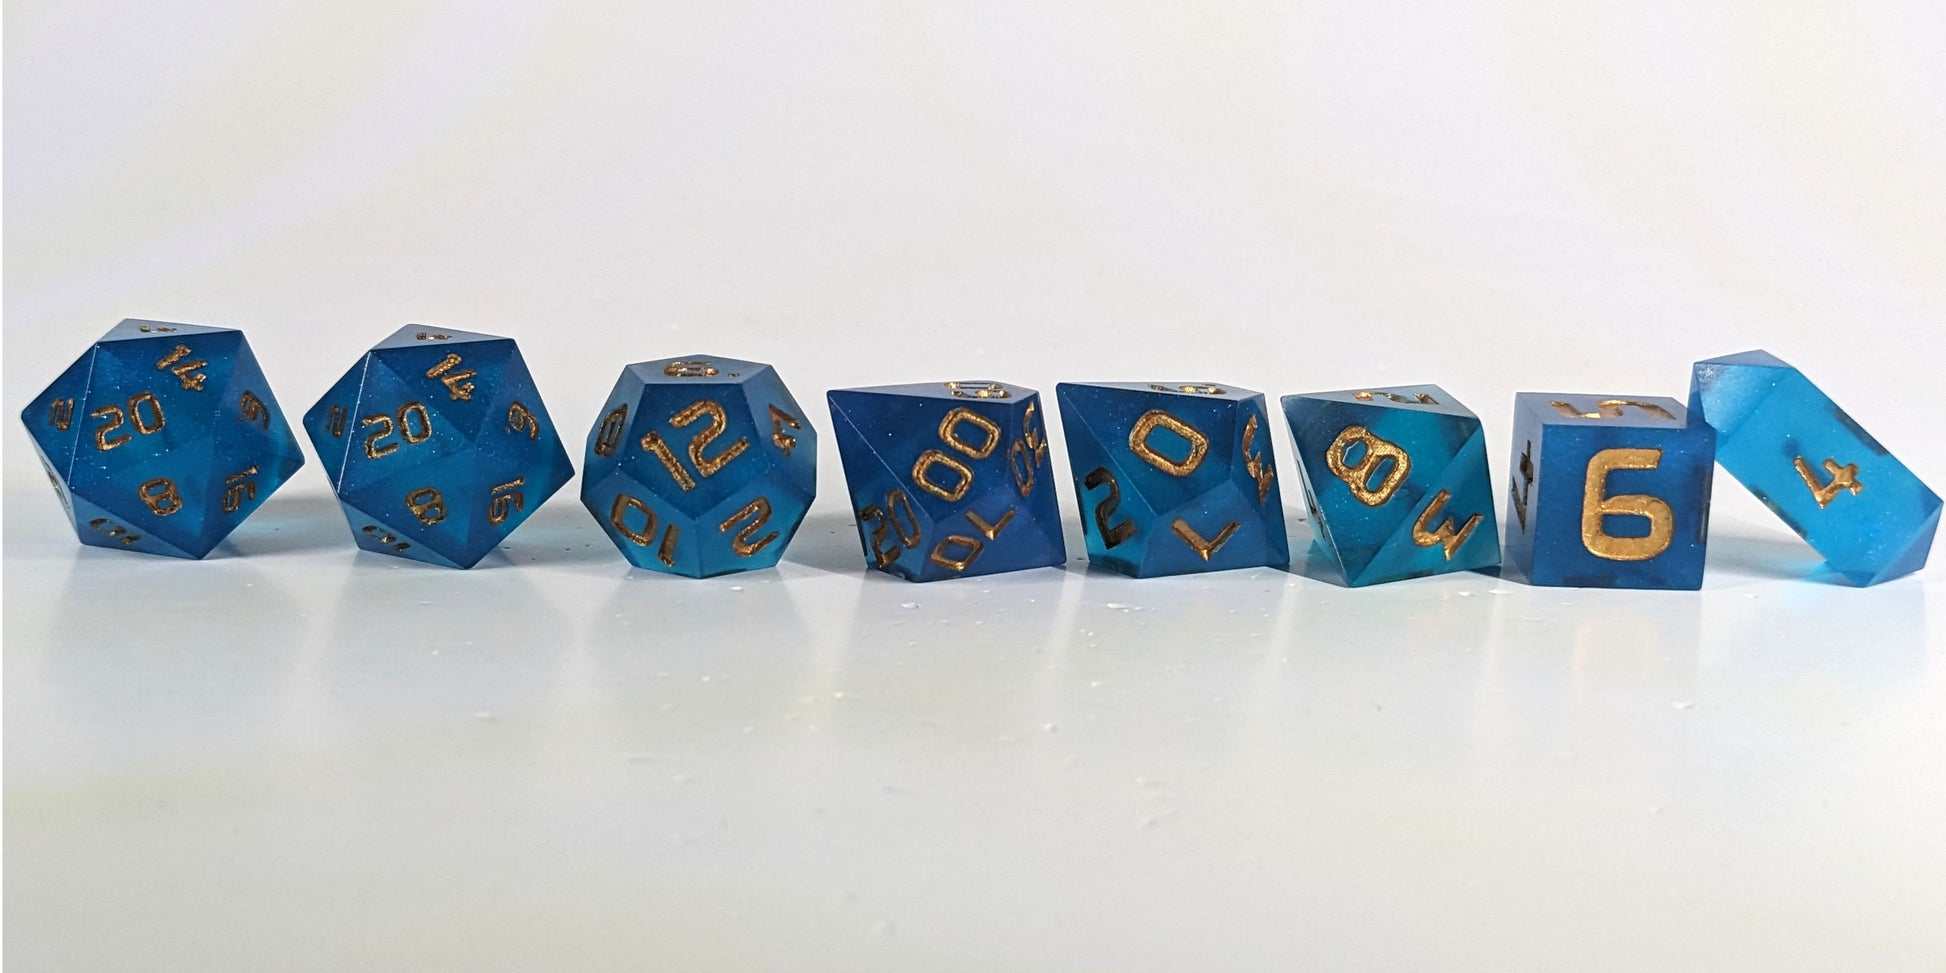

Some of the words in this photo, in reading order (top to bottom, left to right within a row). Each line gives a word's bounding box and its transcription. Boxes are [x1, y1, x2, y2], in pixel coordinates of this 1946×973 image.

[156, 344, 208, 391] 14
[426, 353, 477, 401] 14
[89, 392, 166, 451] 20
[362, 401, 433, 460] 20
[640, 399, 750, 492] 12
[912, 407, 1001, 502] 00
[1128, 408, 1209, 477] 0
[138, 477, 183, 517] 8
[1325, 423, 1411, 508] 8
[1793, 455, 1864, 509] 4
[405, 486, 448, 526] 8
[610, 493, 681, 568] 10
[719, 495, 780, 557] 2
[858, 488, 921, 568] 20
[1083, 465, 1137, 550] 2
[1412, 489, 1484, 561] 3
[1581, 447, 1674, 562] 6
